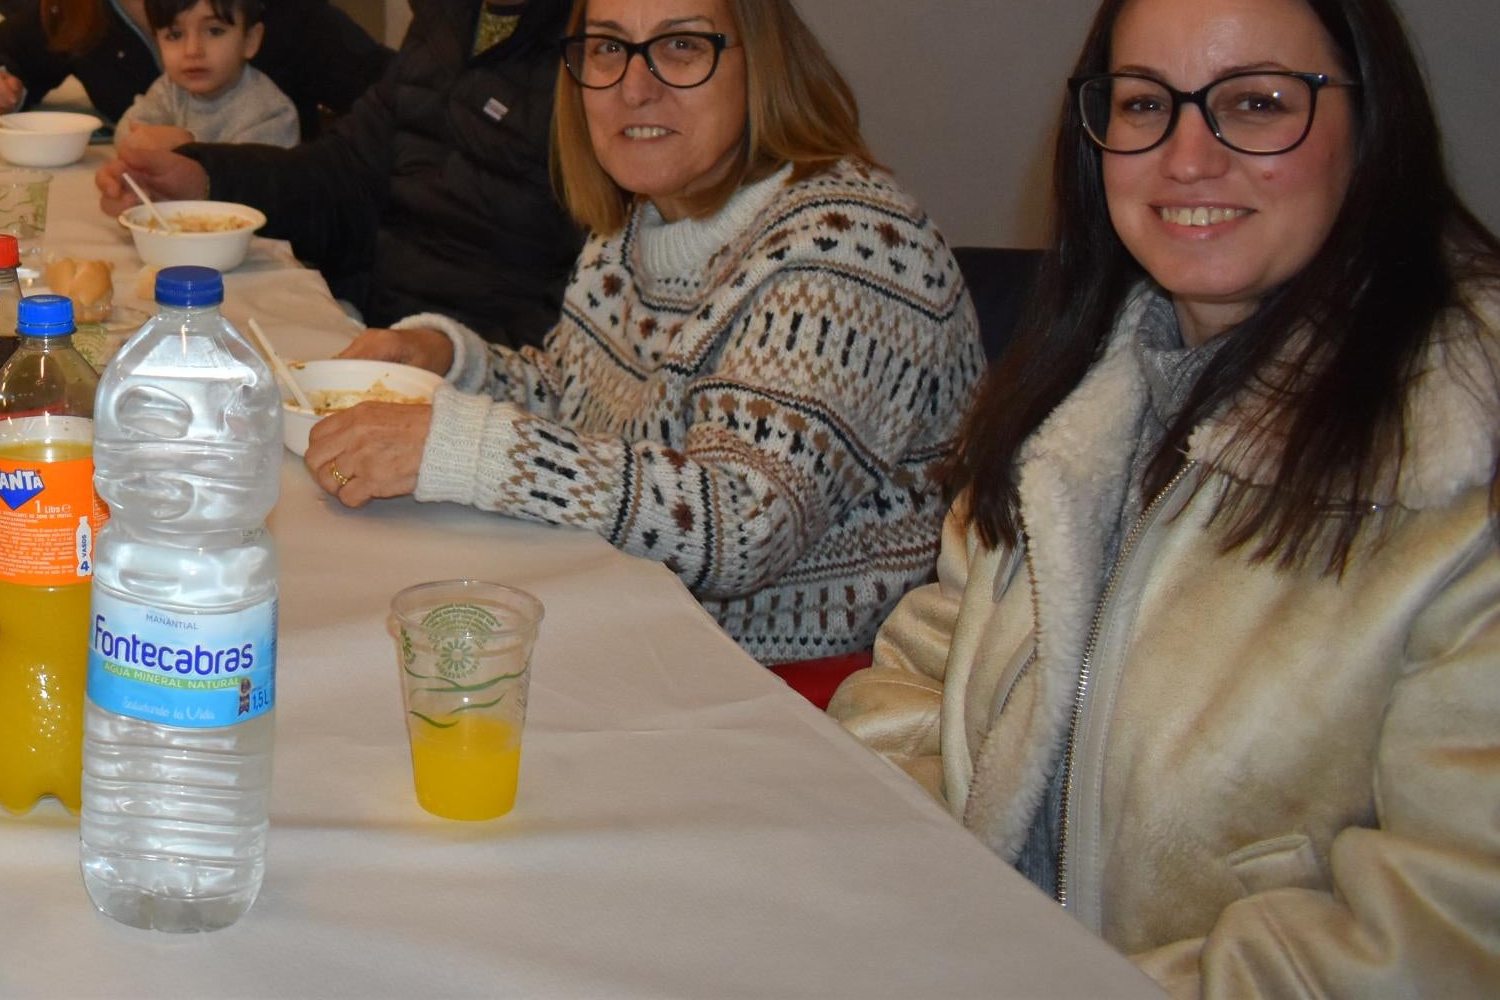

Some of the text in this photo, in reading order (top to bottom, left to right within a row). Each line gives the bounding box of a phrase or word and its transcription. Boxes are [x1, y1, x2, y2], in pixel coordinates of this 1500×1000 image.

[35, 500, 41, 513] 1
[80, 560, 90, 572] 4
[145, 613, 199, 630] MANANTIAL
[94, 613, 254, 676] Fontecabras
[104, 661, 241, 690] AGUA MINERAL NATURAL
